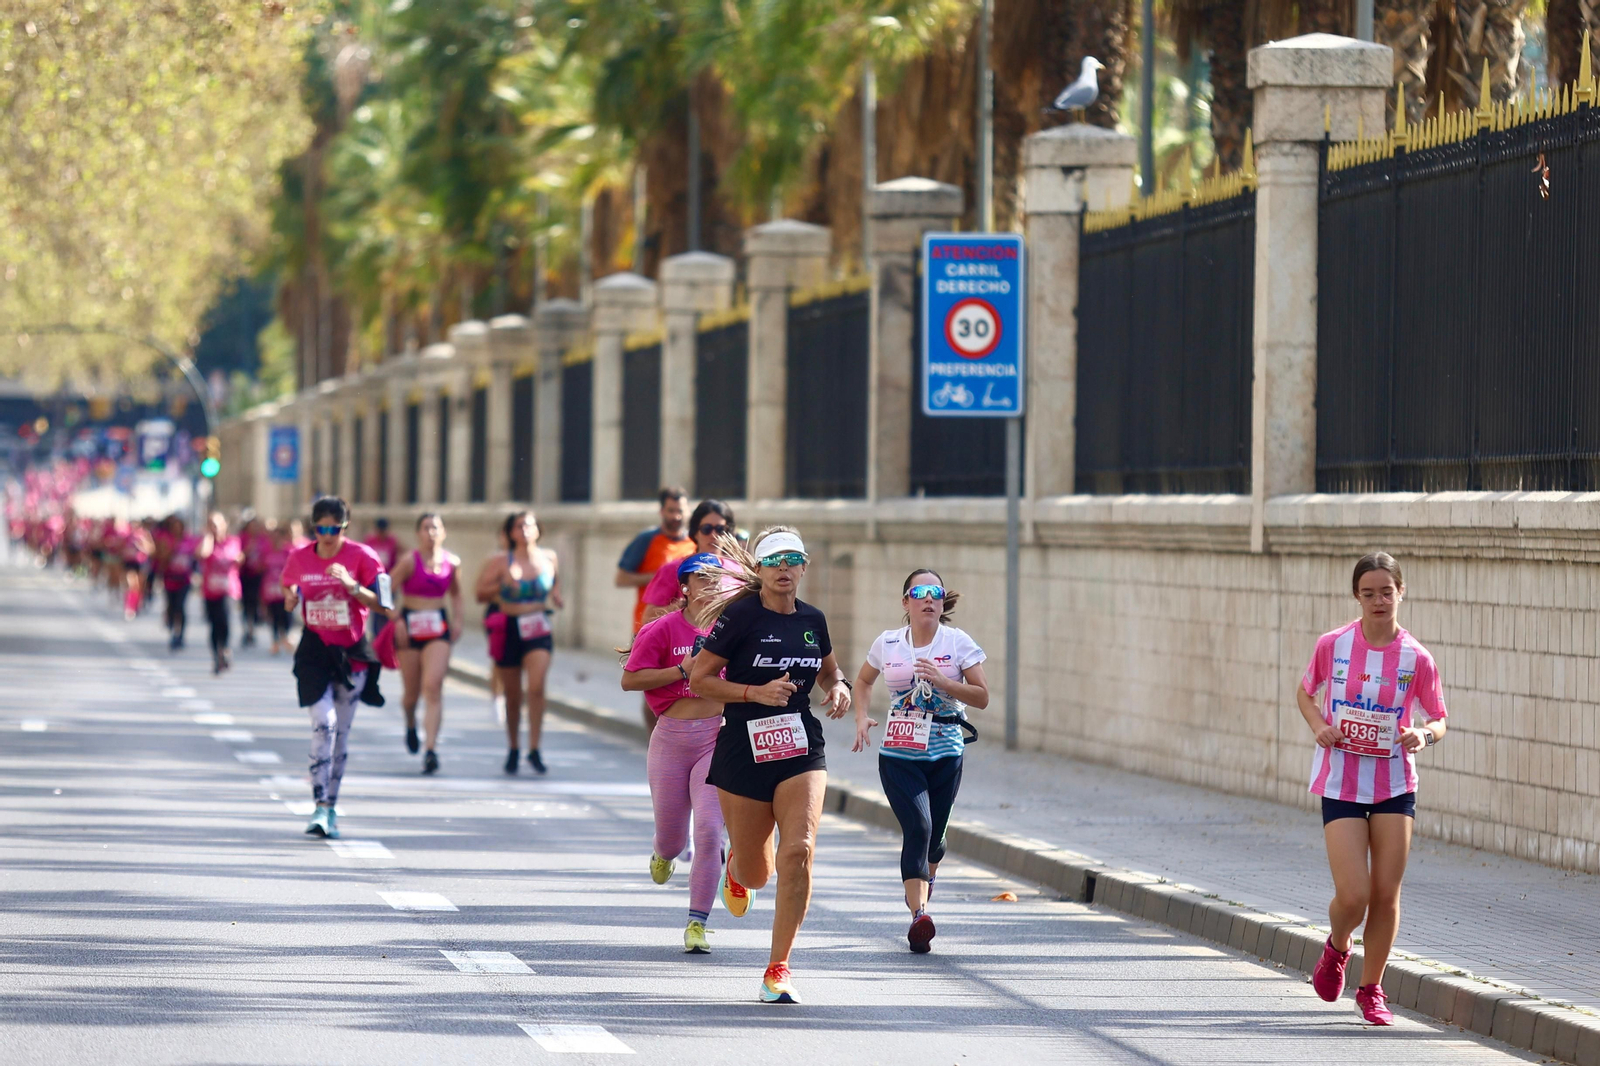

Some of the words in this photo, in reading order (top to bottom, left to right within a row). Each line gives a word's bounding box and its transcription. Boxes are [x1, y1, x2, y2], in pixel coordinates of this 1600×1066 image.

[932, 245, 1018, 260] ATENCIÓN
[945, 263, 1001, 277] CARRIL
[936, 280, 1010, 294] DERECHO
[958, 319, 990, 338] 30
[930, 362, 1017, 377] PREFERENCIA
[1346, 708, 1366, 718] CARRERA
[1371, 713, 1391, 722] MUJERES
[755, 718, 776, 728] CARRERA
[888, 723, 913, 736] 4700
[757, 729, 792, 748] 4098
[1342, 722, 1377, 741] 1936
